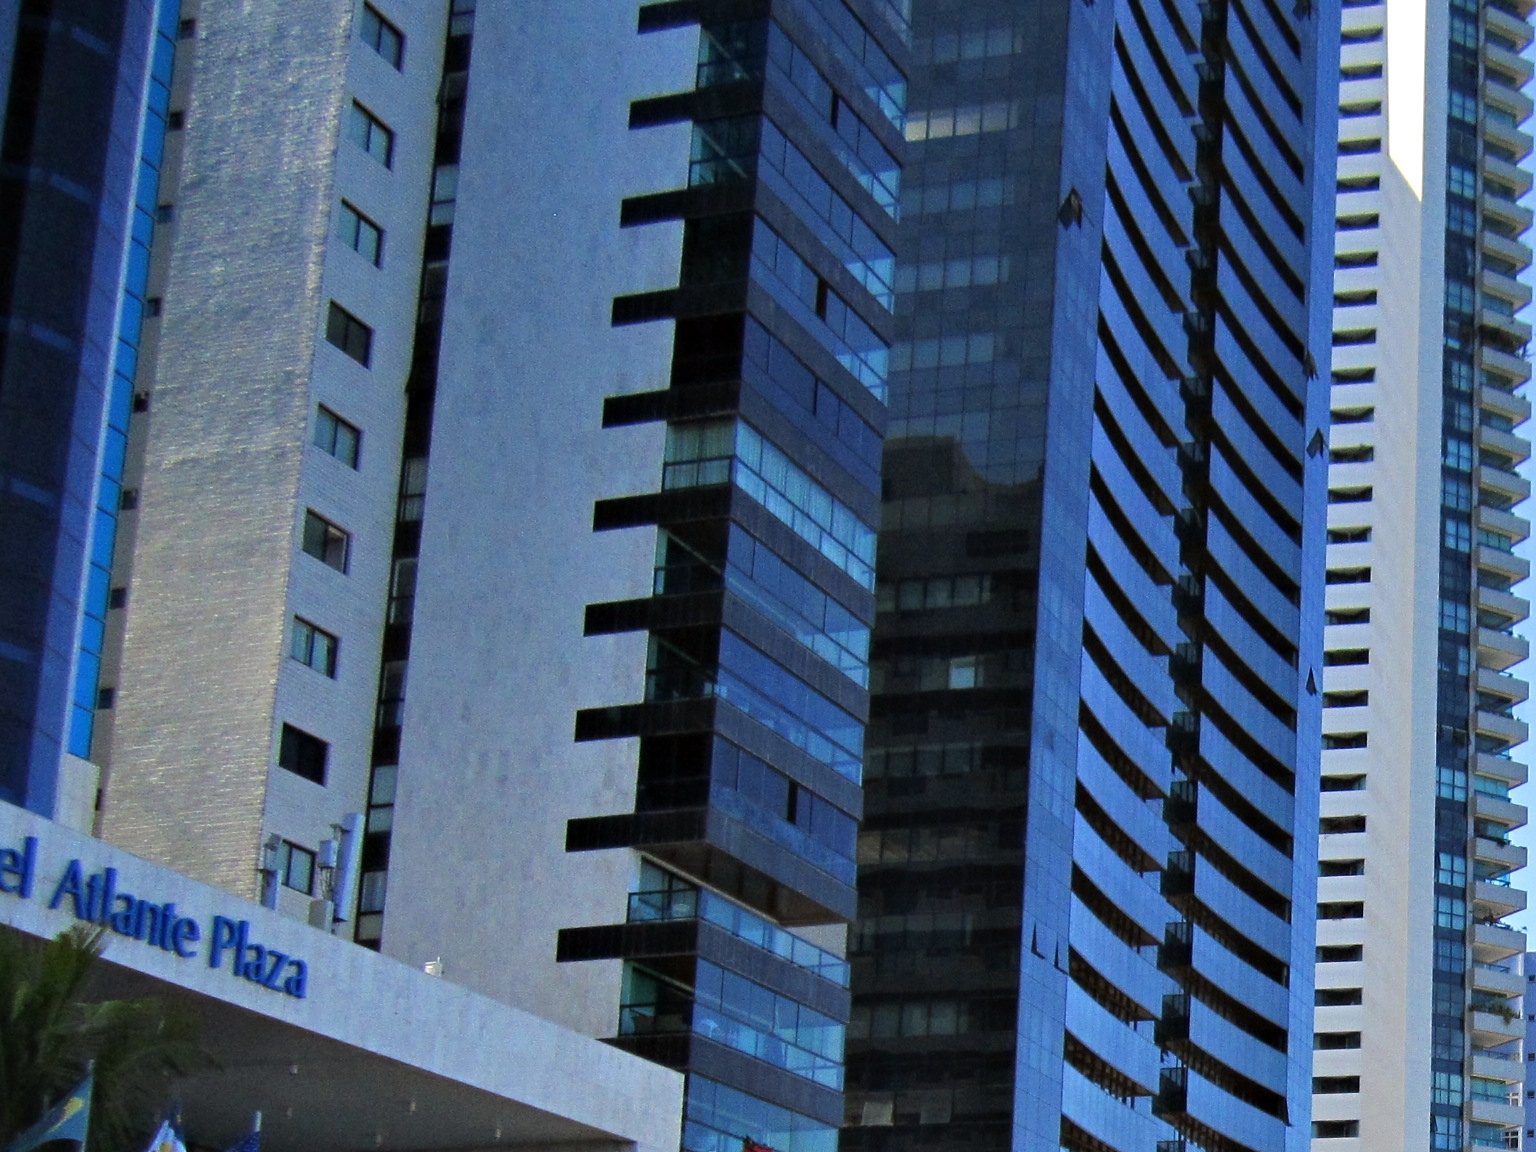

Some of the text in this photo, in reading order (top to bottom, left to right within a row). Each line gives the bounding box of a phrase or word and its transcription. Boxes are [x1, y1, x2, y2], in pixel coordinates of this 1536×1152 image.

[0, 836, 309, 999] el Atlante Plaza
